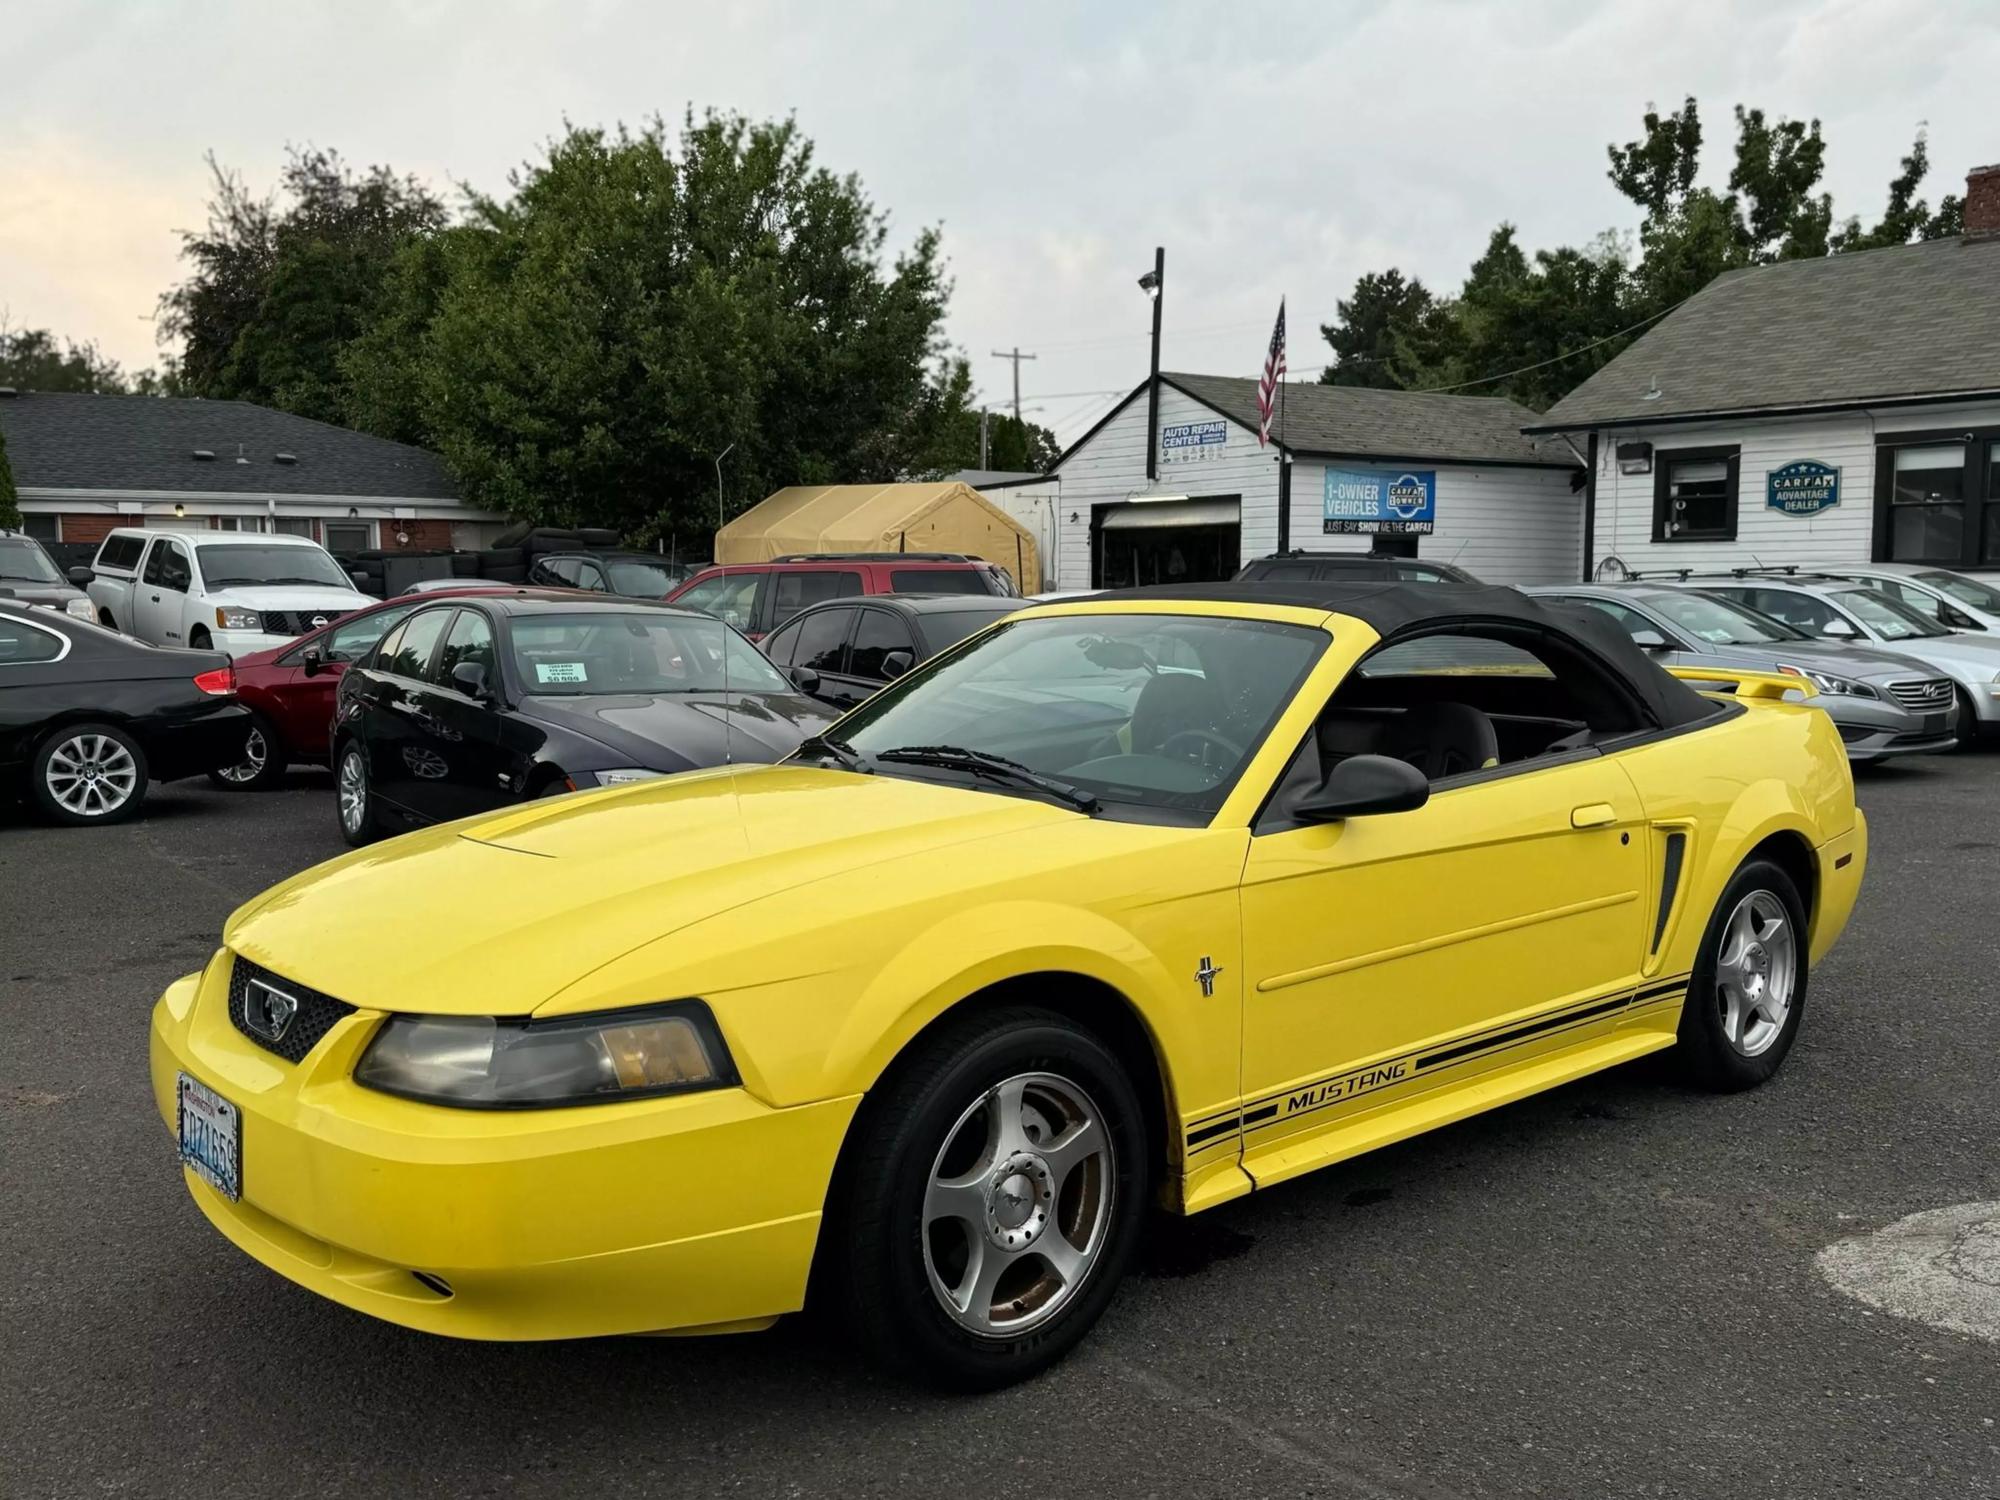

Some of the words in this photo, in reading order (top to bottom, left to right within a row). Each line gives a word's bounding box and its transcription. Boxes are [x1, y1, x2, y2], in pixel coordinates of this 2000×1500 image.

[1164, 427, 1190, 438] AUTO
[1191, 423, 1226, 435] REPAIR
[1163, 435, 1201, 447] CENTER
[1773, 475, 1835, 489] CARFAX
[1327, 484, 1379, 500] 1-OWNER
[1776, 489, 1830, 501] ADVANTAGE
[1327, 500, 1380, 516] VEHICLES
[1785, 500, 1820, 511] DEALER
[1325, 521, 1343, 532] JUST
[1344, 521, 1358, 532] SAY
[1358, 521, 1380, 532] SHOW
[1380, 522, 1392, 532] ME
[1392, 522, 1405, 532] THE
[1405, 522, 1432, 532] CARFAX
[1287, 1062, 1407, 1112] MUSTANG
[184, 1090, 217, 1118] WASHINGTON
[183, 1107, 236, 1181] CDZ1659
